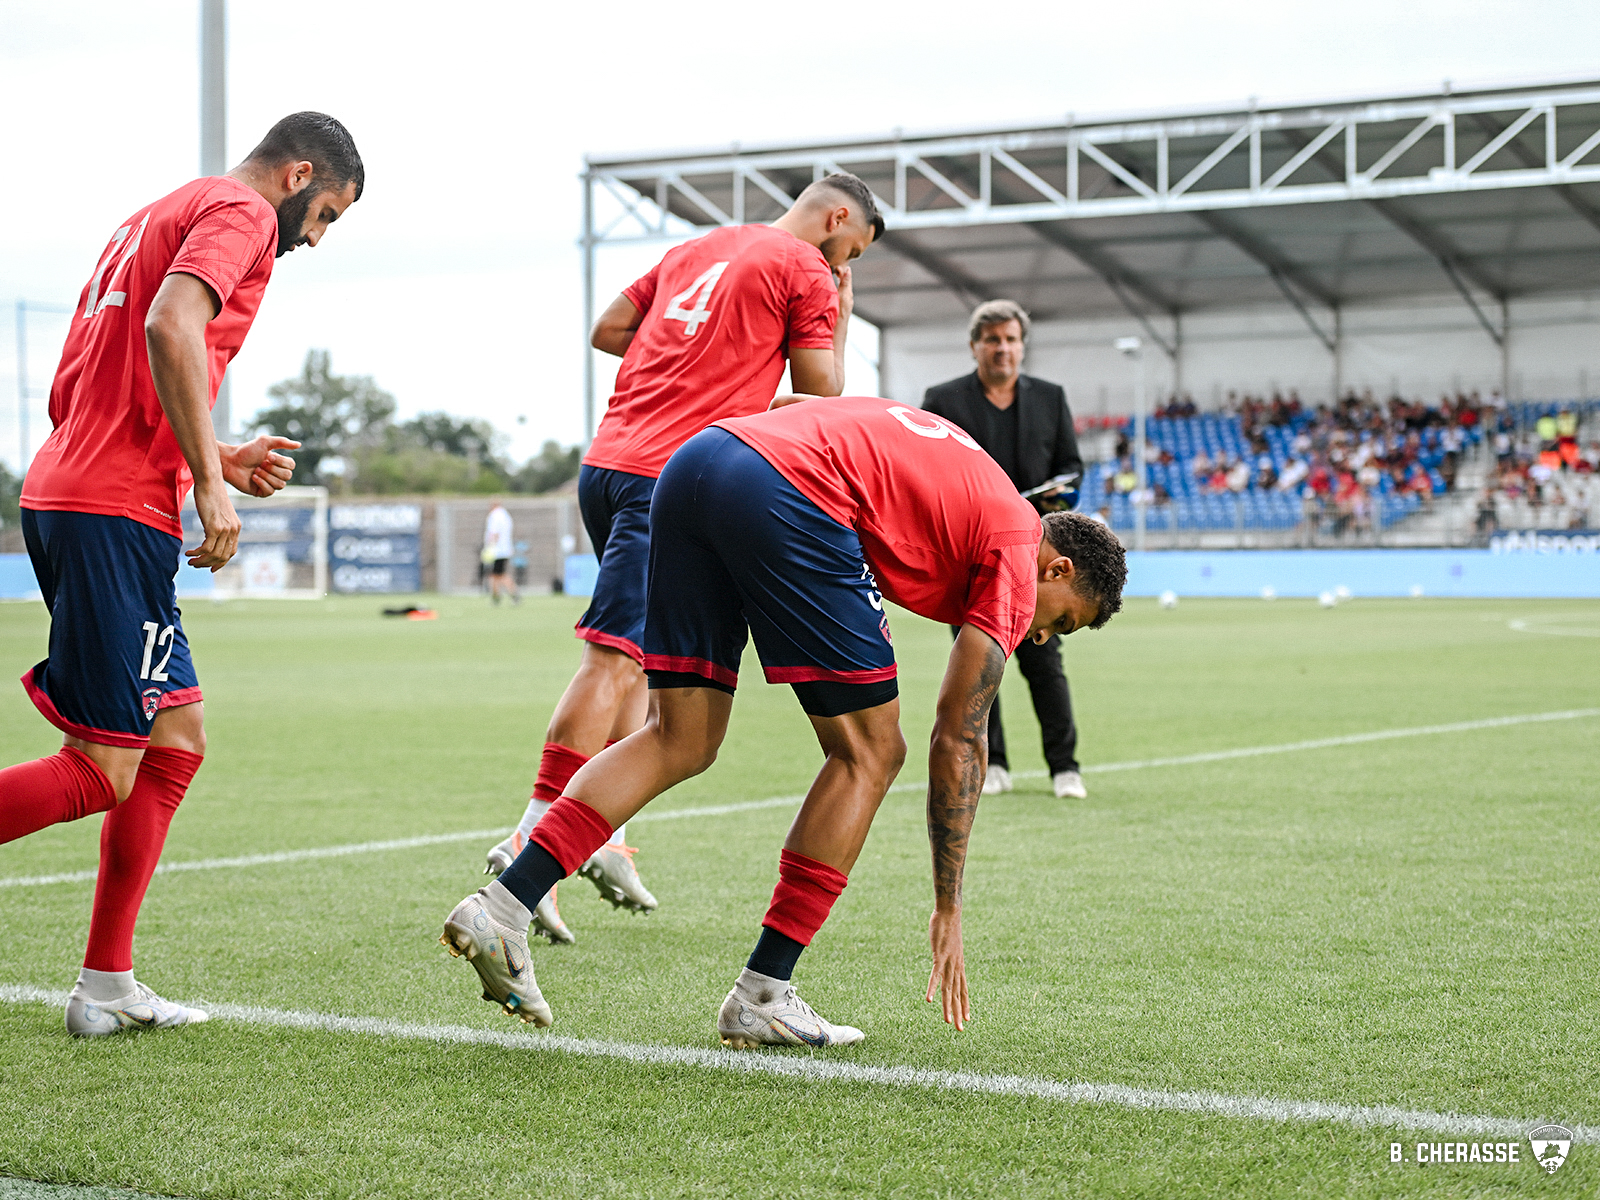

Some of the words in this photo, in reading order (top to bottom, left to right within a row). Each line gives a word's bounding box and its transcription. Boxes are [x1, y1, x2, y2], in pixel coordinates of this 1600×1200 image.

[83, 212, 150, 319] 12
[663, 261, 730, 336] 4
[140, 621, 175, 682] 12
